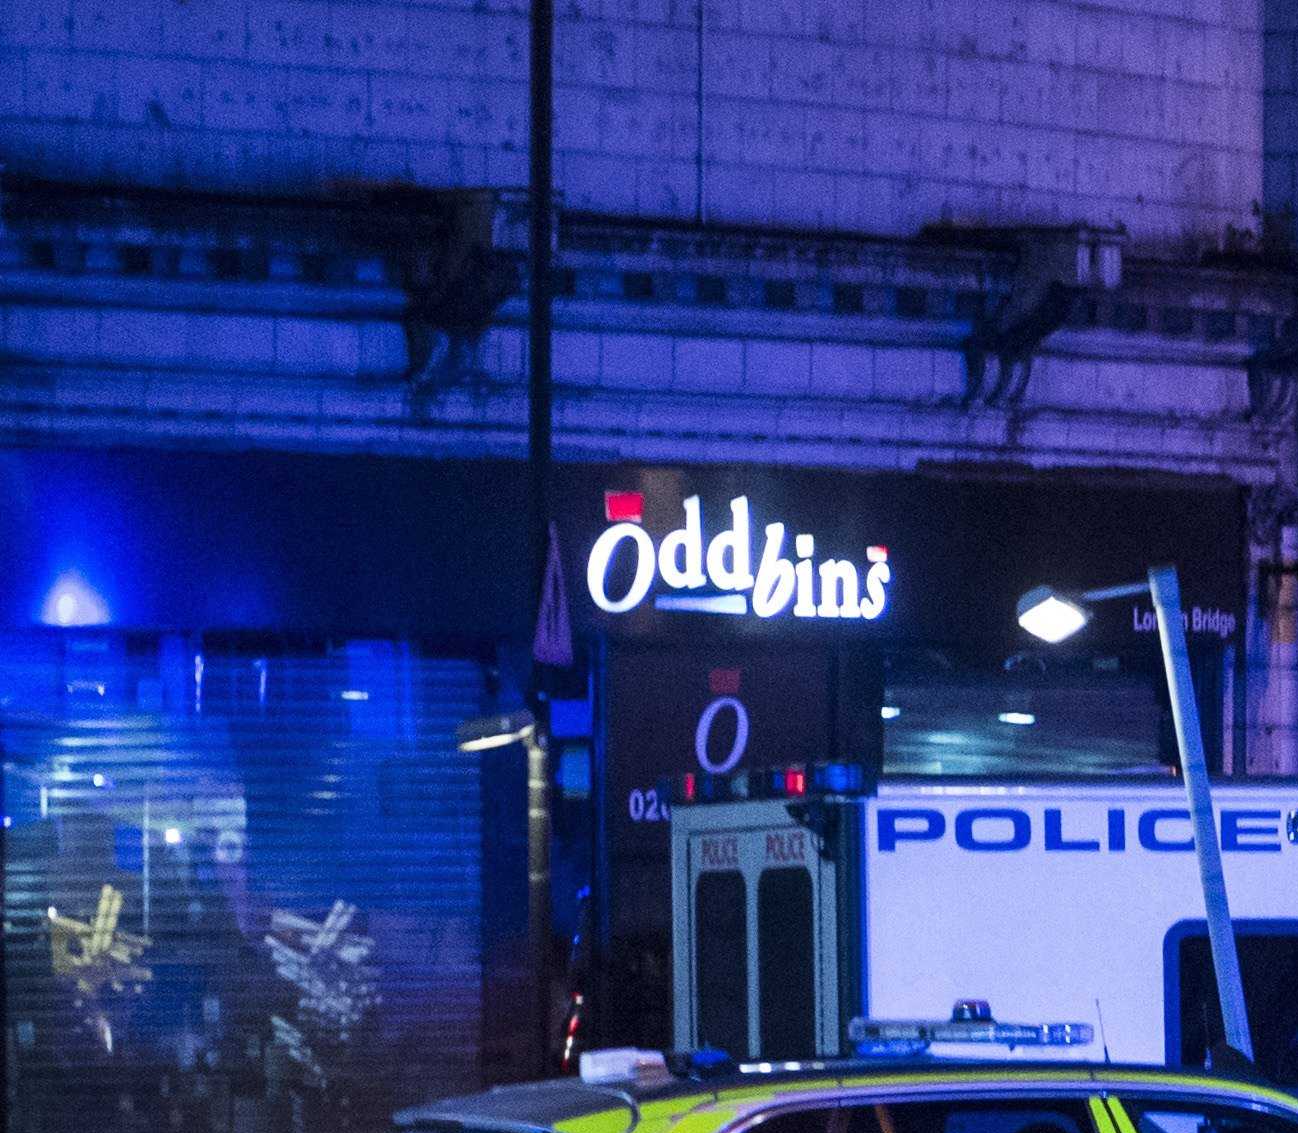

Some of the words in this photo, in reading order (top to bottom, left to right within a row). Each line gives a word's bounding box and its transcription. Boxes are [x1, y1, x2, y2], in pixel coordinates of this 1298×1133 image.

[586, 494, 891, 619] Oddbins
[1191, 605, 1237, 639] Bridge
[765, 830, 805, 865] POLICE
[876, 807, 1282, 853] POLICE
